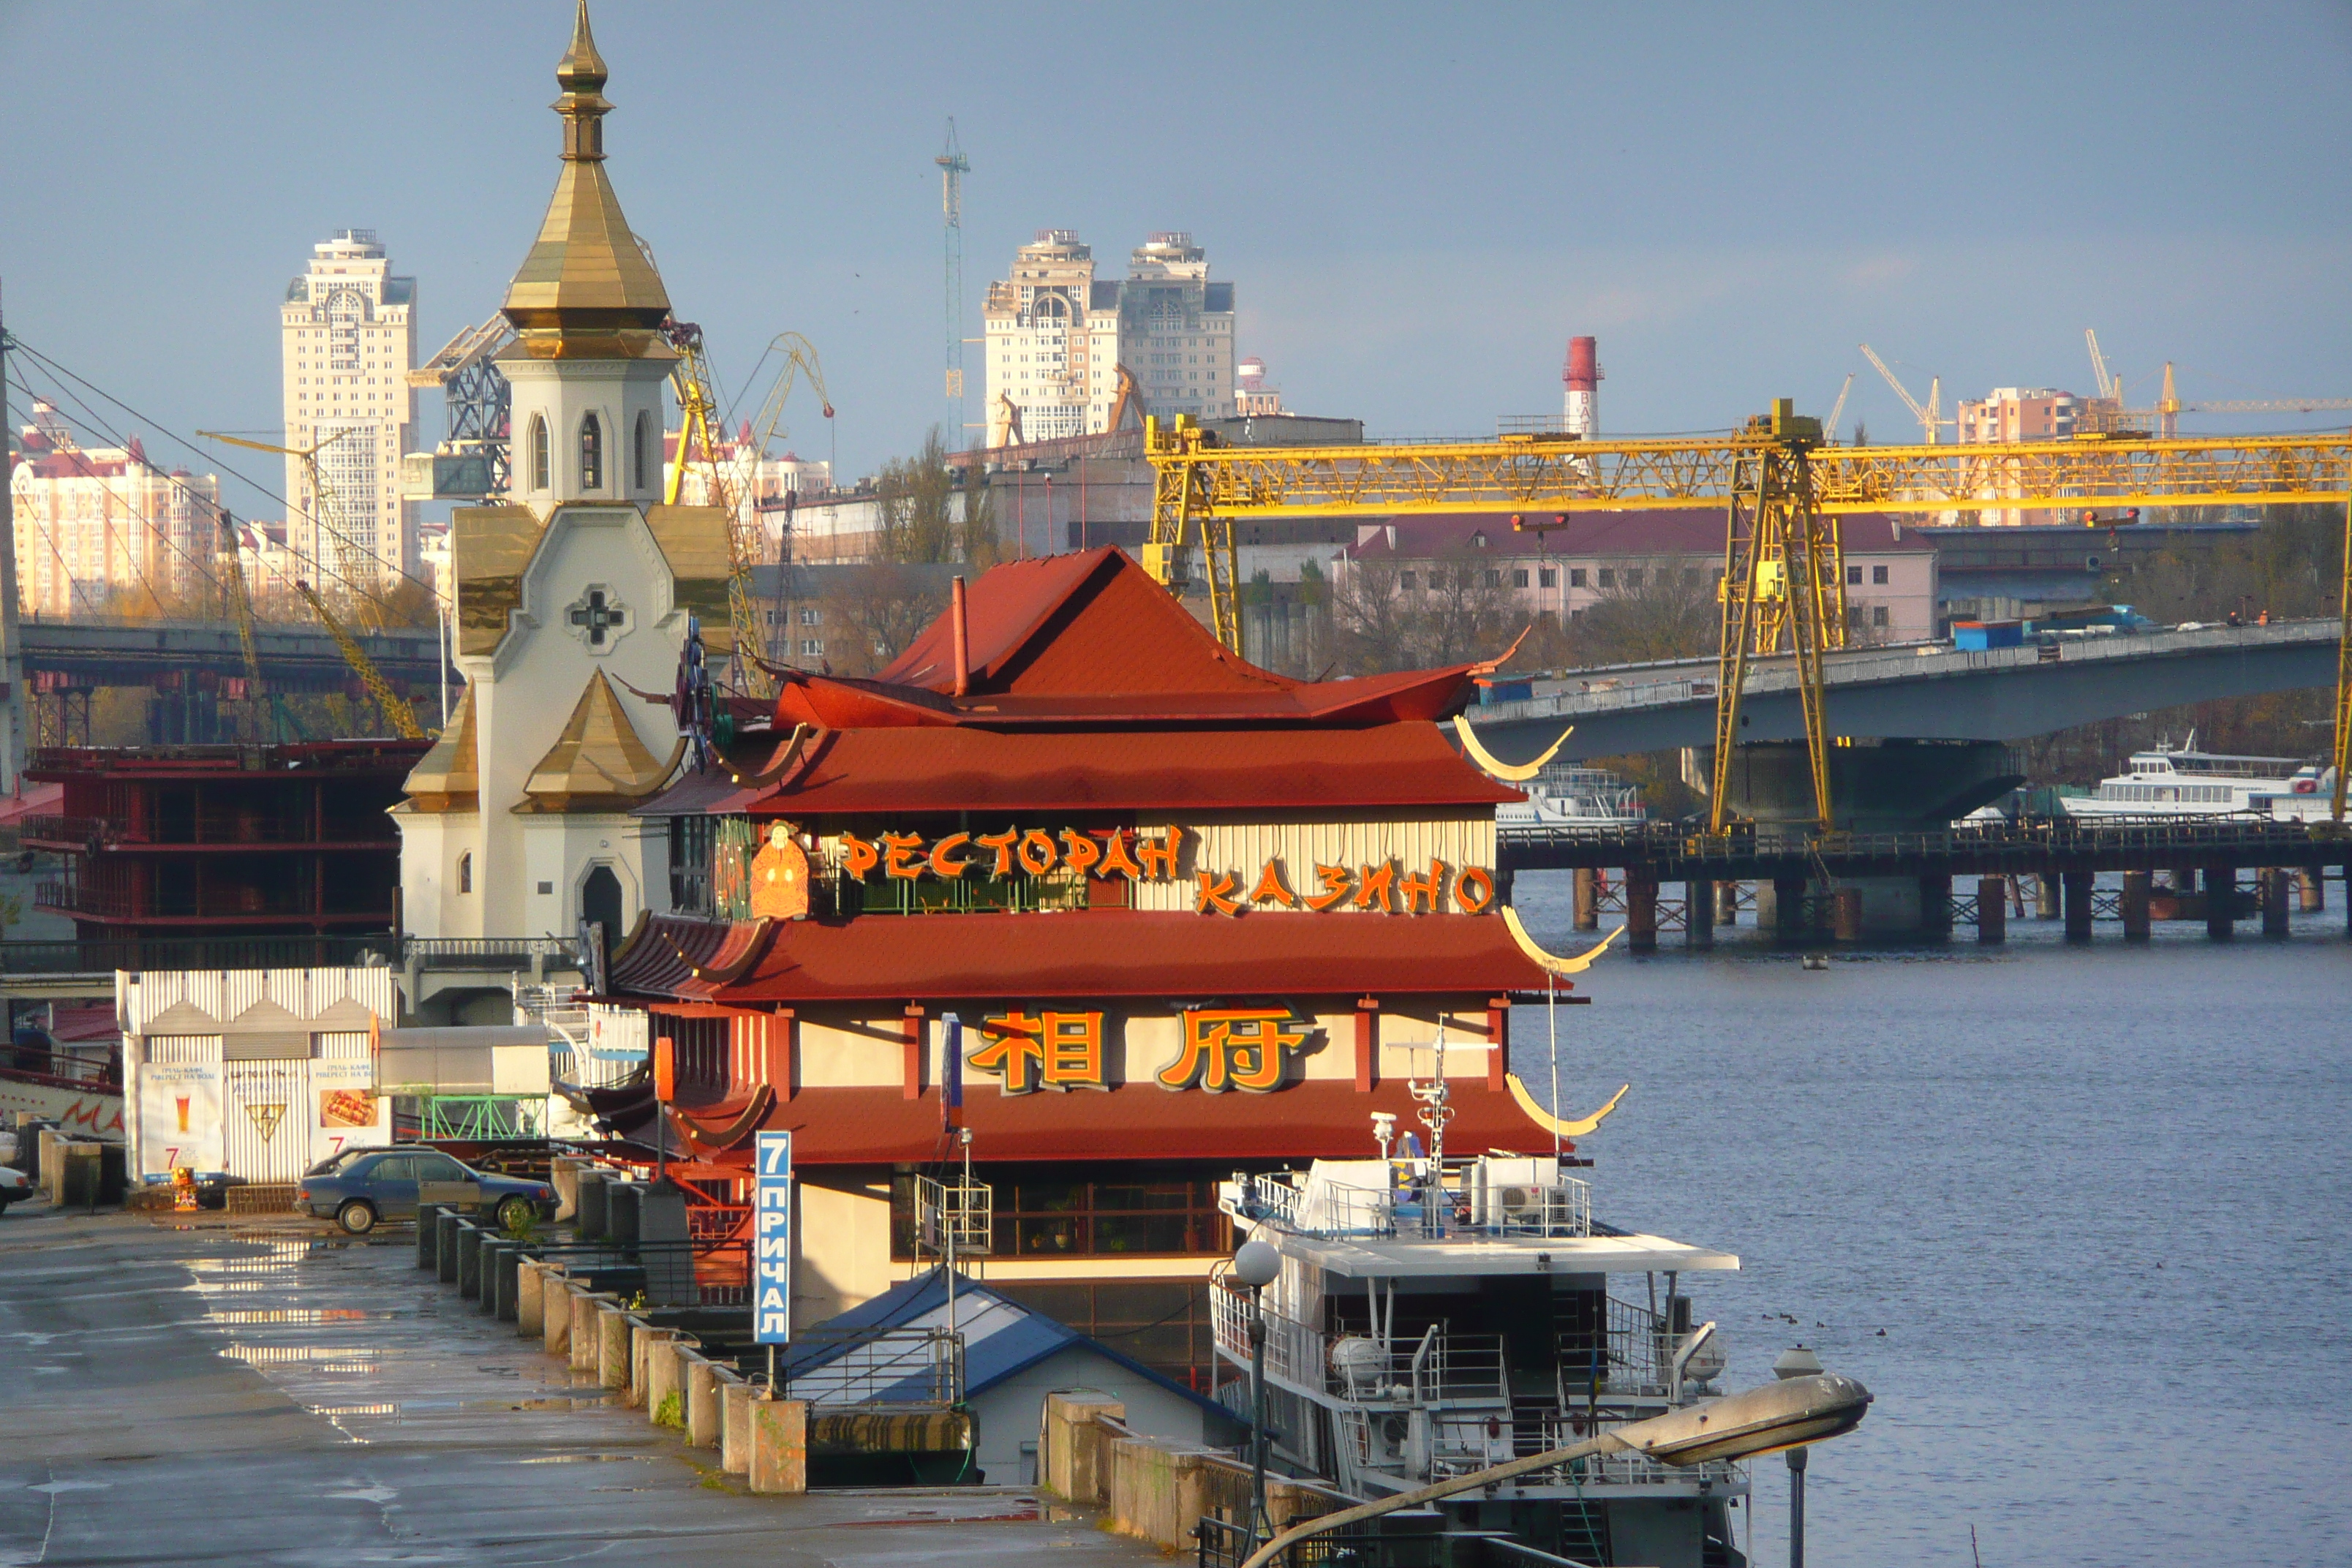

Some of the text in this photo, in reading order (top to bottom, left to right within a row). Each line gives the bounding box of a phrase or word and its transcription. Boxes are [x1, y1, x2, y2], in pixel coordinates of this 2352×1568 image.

[839, 823, 1495, 917] РЕСТОРАН КАЗИНО
[965, 1000, 1308, 1094] 相府
[165, 1147, 180, 1170] 7
[328, 1136, 345, 1154] 7
[761, 1138, 787, 1334] 7 ПРИЧАЛ
